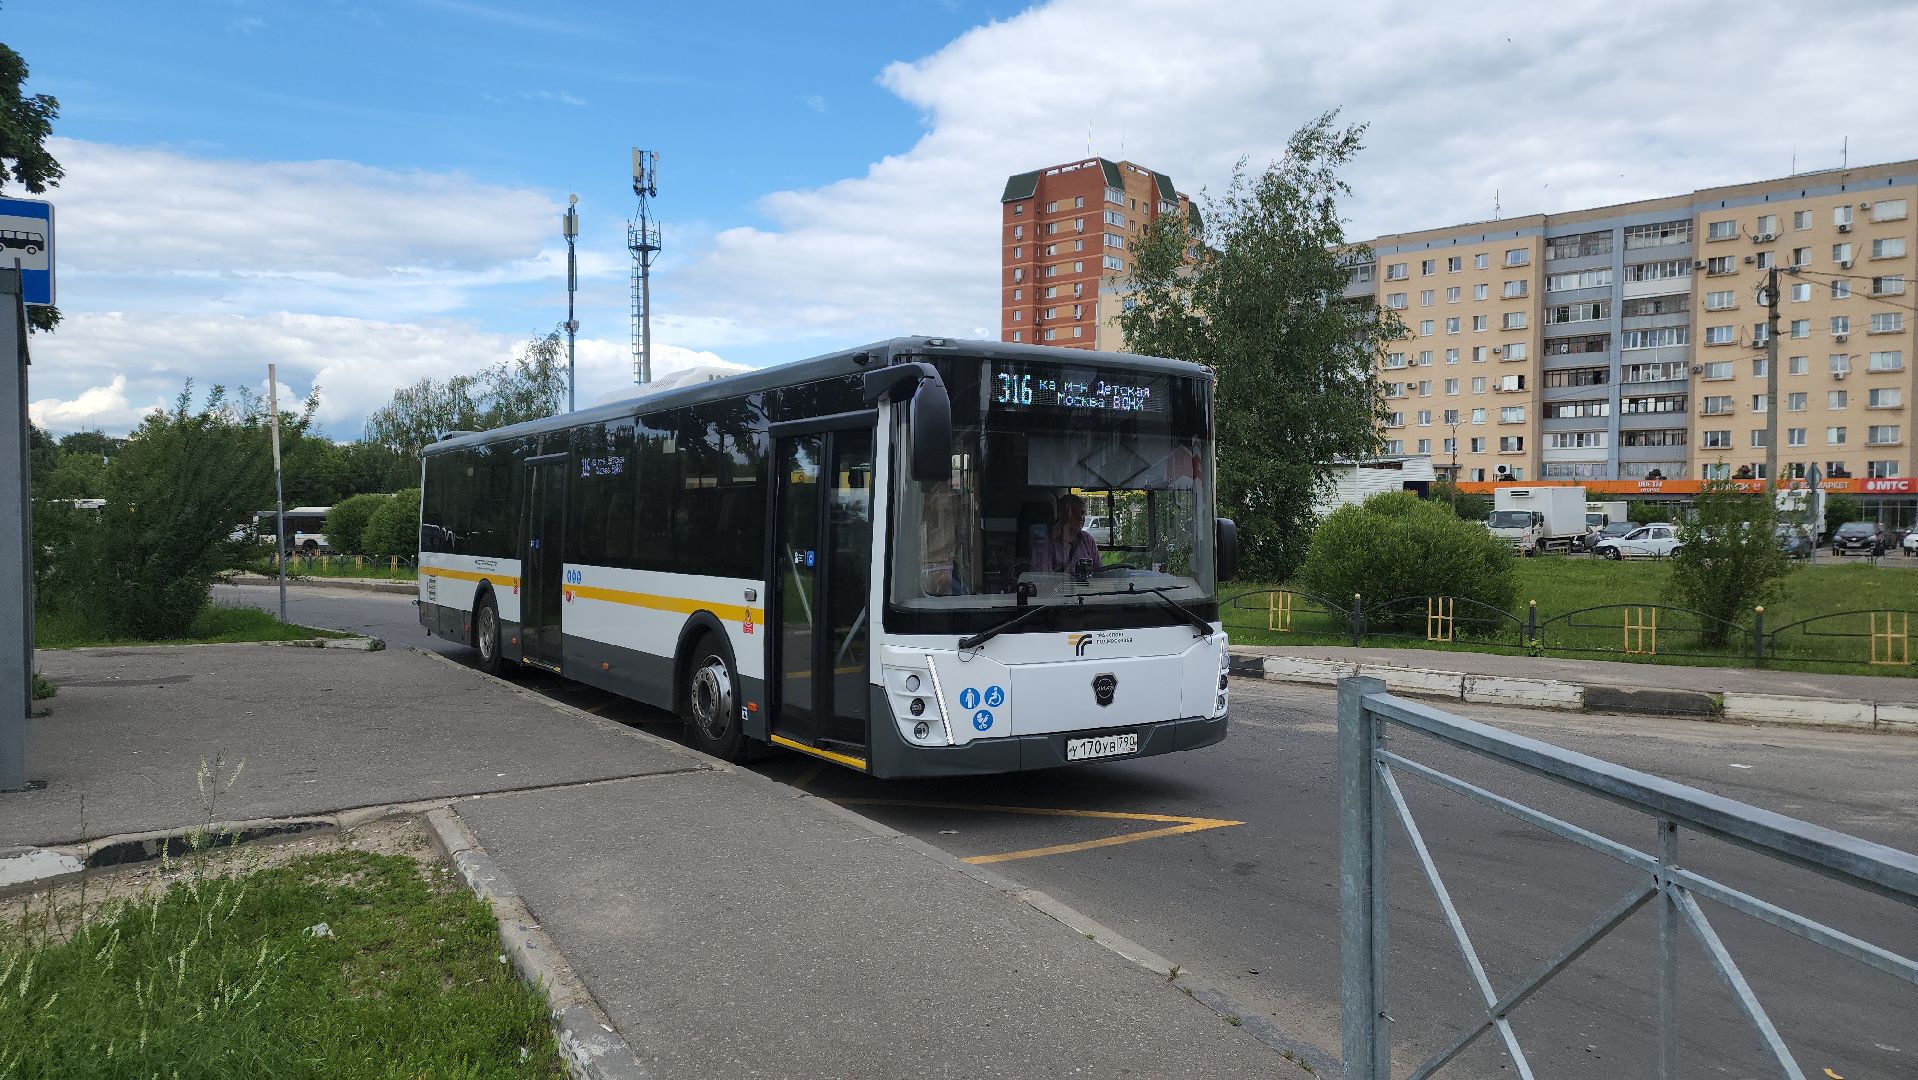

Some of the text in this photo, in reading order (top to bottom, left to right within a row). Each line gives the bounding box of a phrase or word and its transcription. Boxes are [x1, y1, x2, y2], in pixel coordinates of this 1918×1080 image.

[998, 372, 1032, 405] 316
[1097, 380, 1150, 397] Детская
[1057, 391, 1105, 408] Москва
[1876, 481, 1909, 490] МТС
